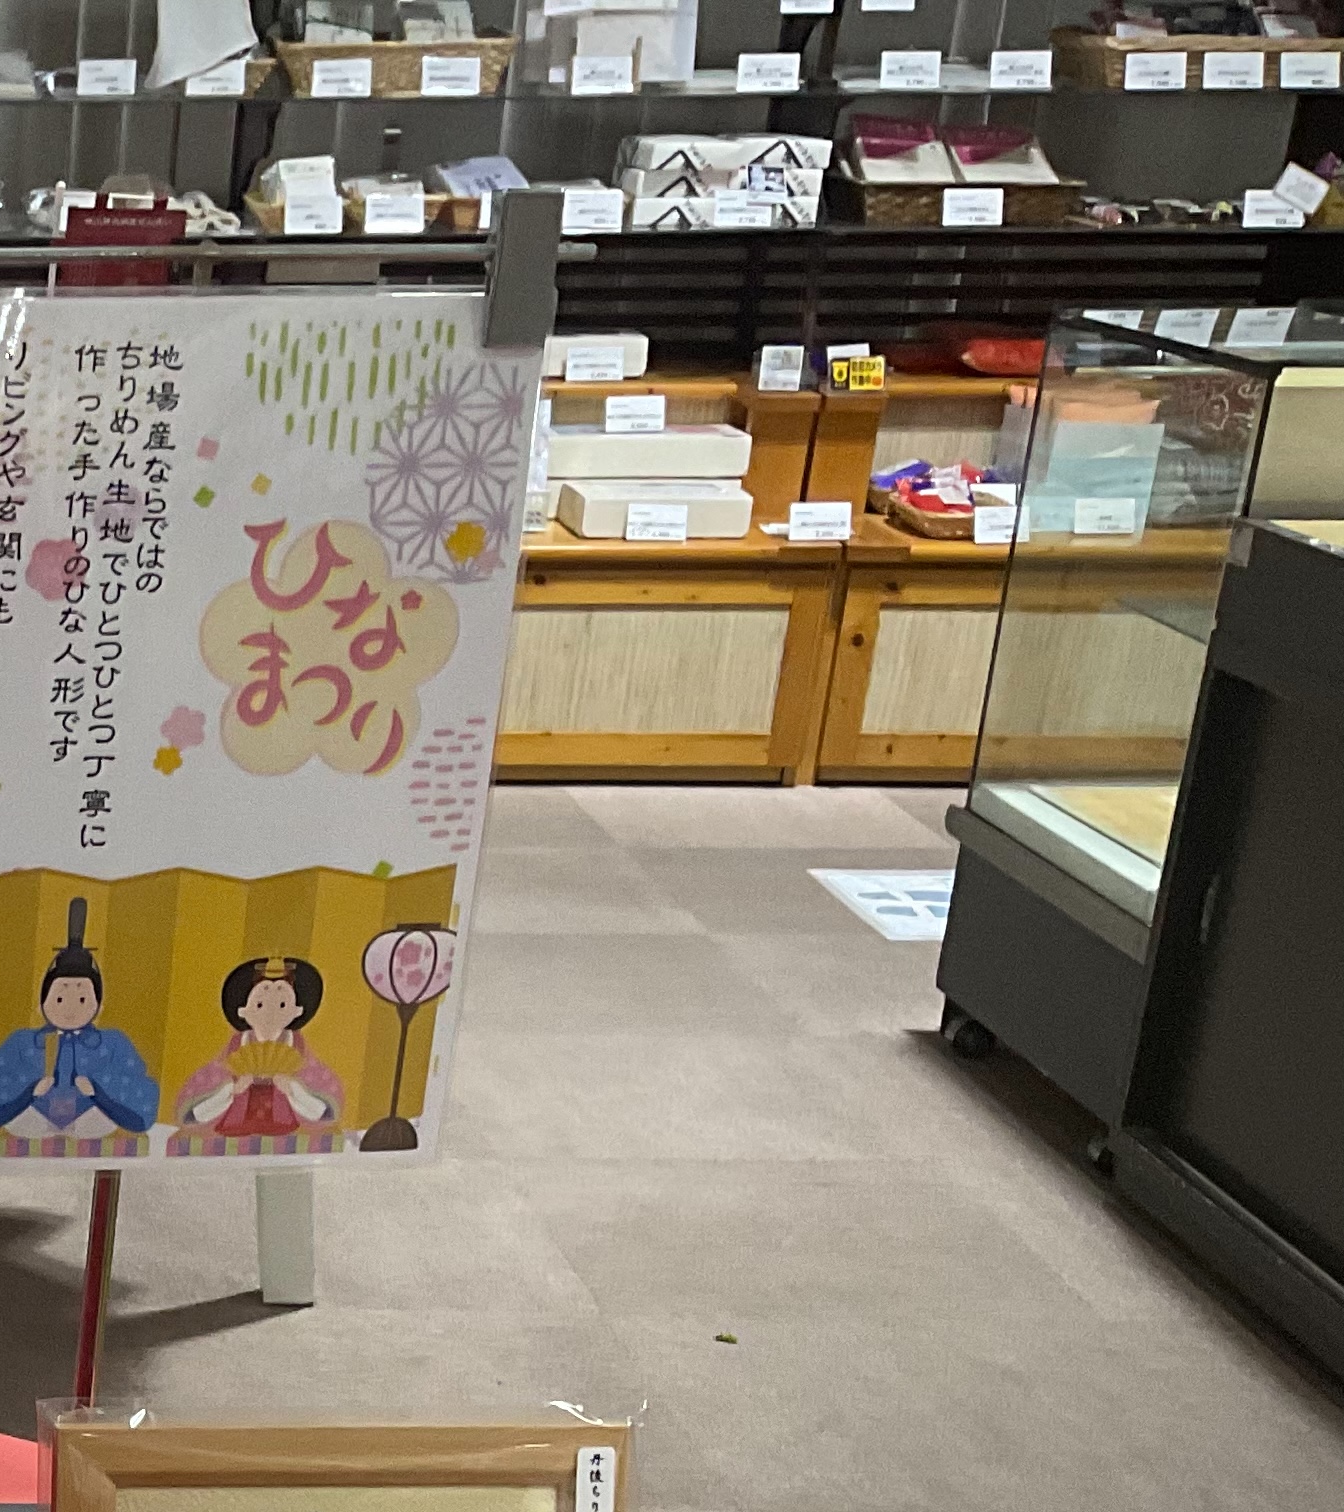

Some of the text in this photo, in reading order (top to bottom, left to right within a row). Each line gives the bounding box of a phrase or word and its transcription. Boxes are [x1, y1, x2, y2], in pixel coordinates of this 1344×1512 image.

[49, 344, 108, 763] 作った手作りのひな人形です
[79, 341, 140, 849] ちりめん生地でひとつひとつ丁寧に
[135, 343, 184, 594] 地場産ならではの
